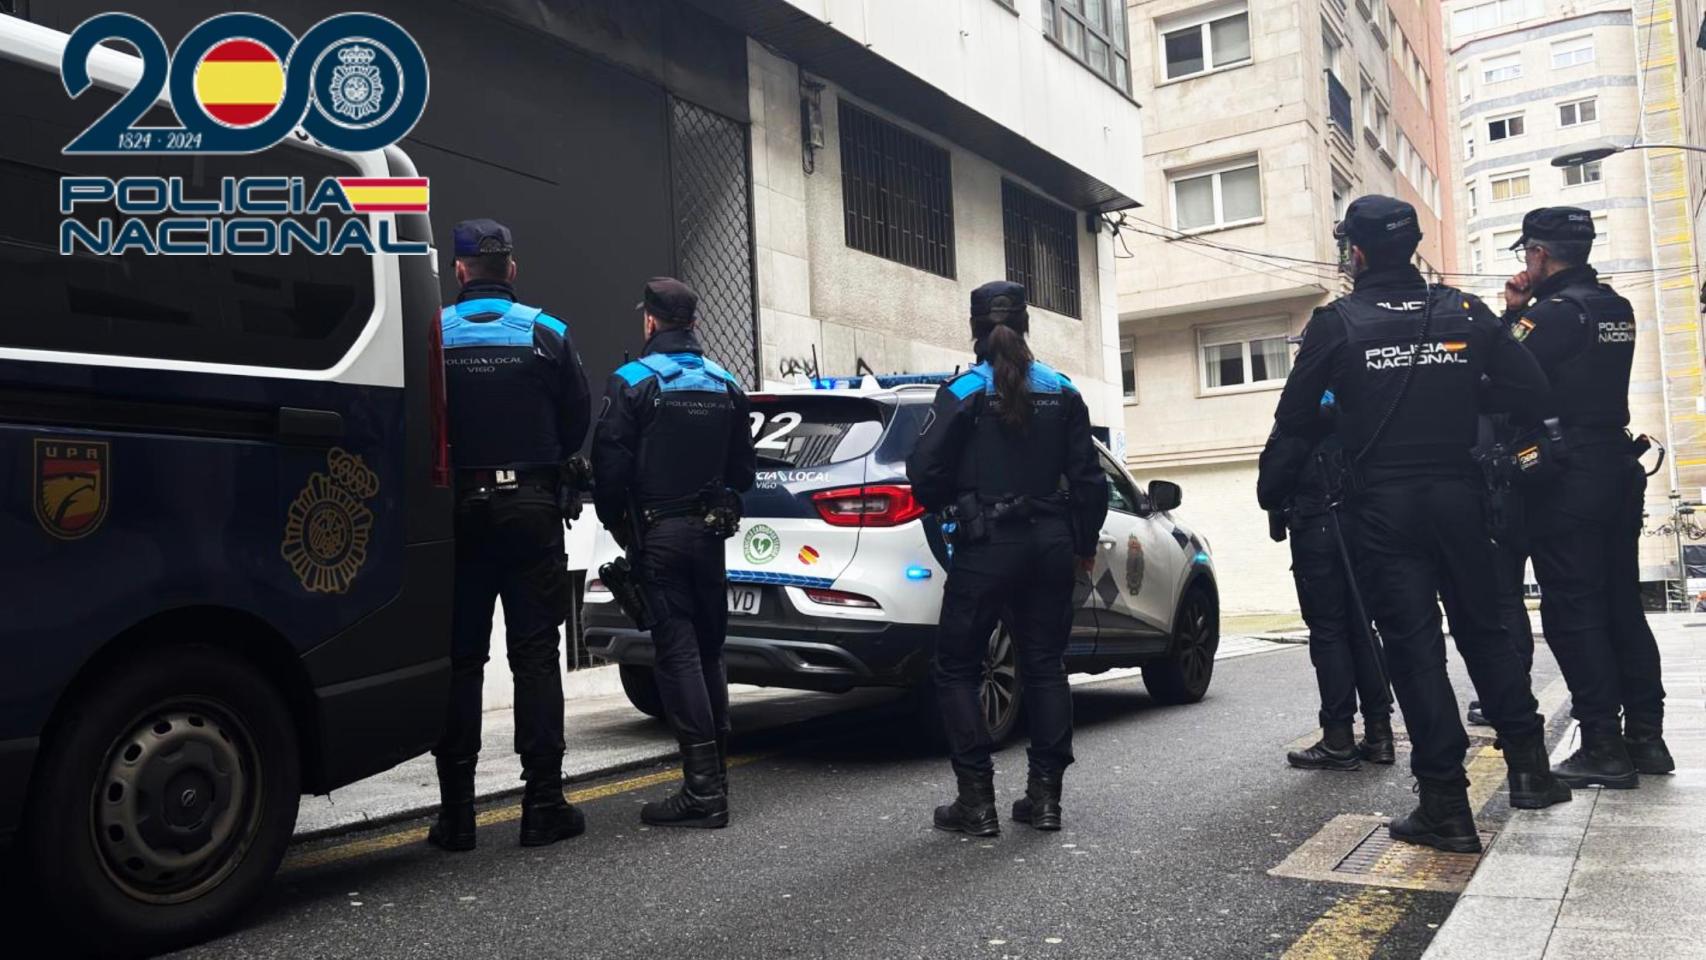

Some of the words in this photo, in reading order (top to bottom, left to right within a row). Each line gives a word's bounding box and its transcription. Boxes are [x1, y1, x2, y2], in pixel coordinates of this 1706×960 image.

[446, 357, 482, 365] OLICIA
[490, 357, 523, 365] LOCAL
[466, 365, 496, 373] VIGO
[788, 471, 831, 482] LOCAL
[755, 482, 777, 490] VIGO
[732, 590, 755, 611] VD
